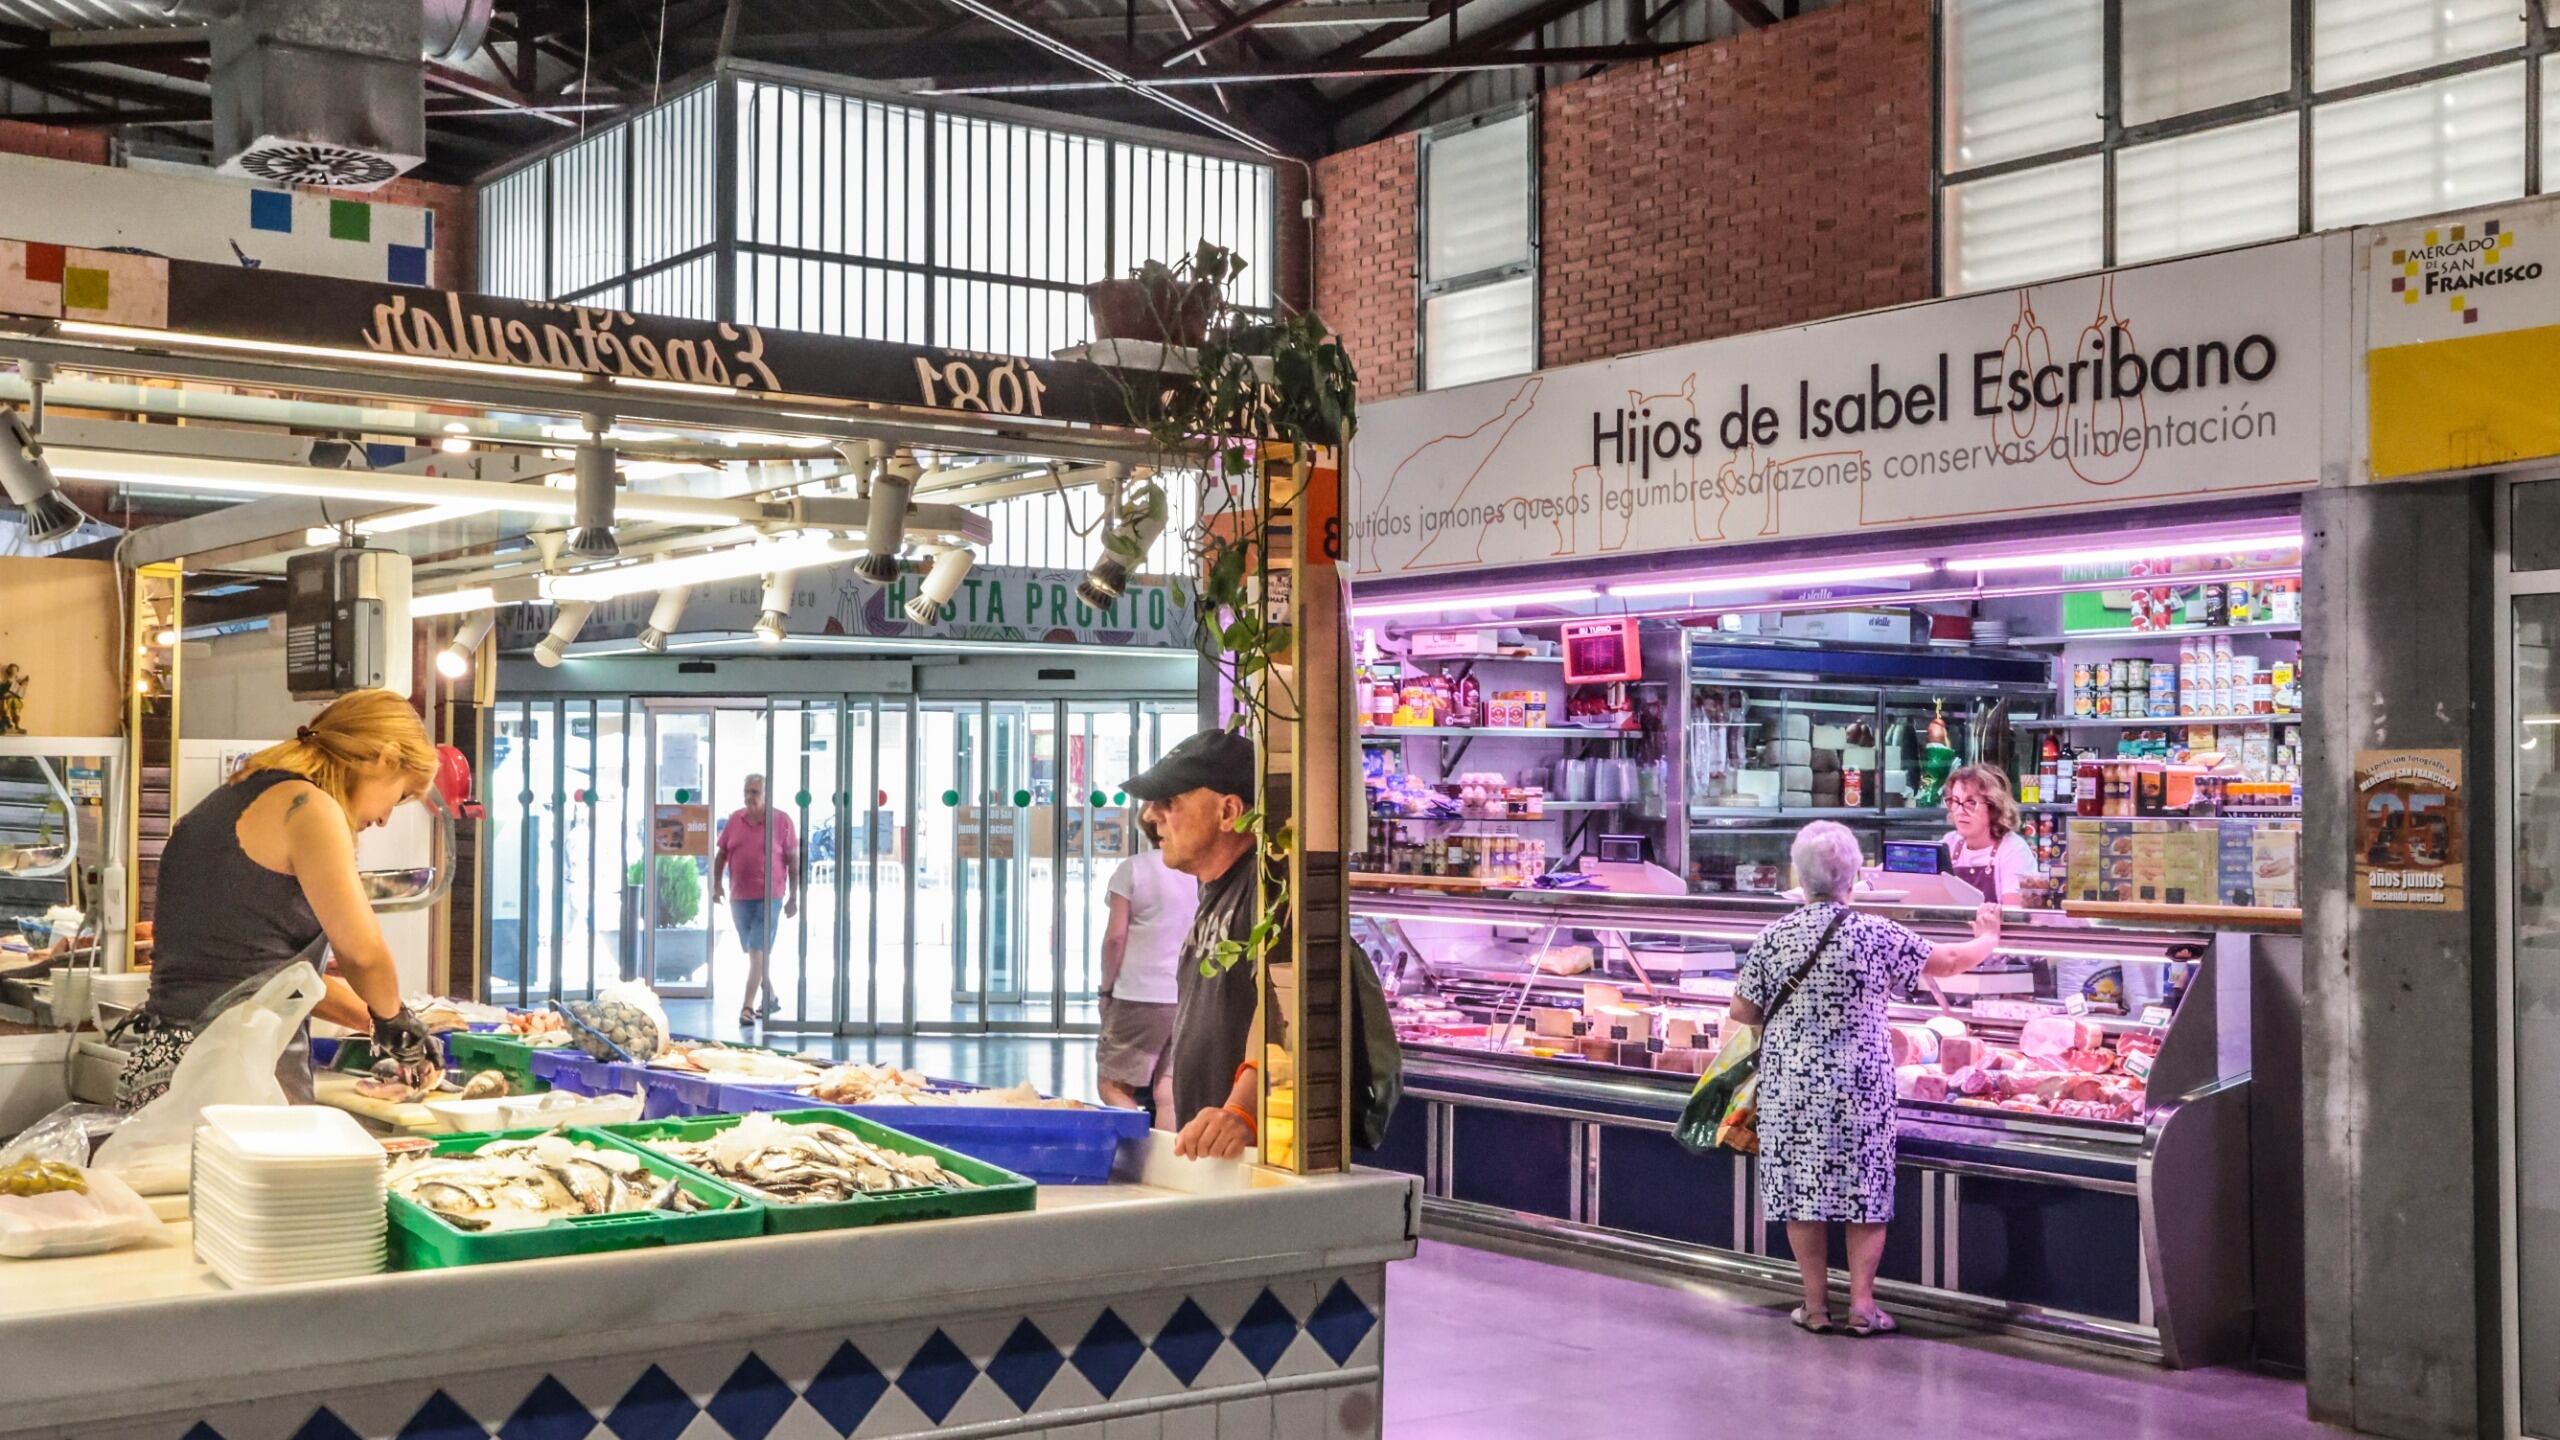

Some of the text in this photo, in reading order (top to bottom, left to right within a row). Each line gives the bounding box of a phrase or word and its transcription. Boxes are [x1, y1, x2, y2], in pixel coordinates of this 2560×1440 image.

[2408, 237, 2496, 262] MERCADO
[2425, 258, 2475, 274] DE SAN
[2425, 262, 2543, 295] FRANCISCO
[1593, 326, 2277, 479] Hijos de Isabel Escribano
[1419, 503, 1505, 541] jamones
[1513, 493, 1590, 530] quesos
[1599, 469, 1725, 519] legumbres
[1736, 456, 1872, 496] salazones
[1883, 434, 2037, 480] conservas
[2050, 401, 2277, 461] alimentación
[2367, 792, 2449, 866] 25
[2368, 868, 2444, 889] años juntos
